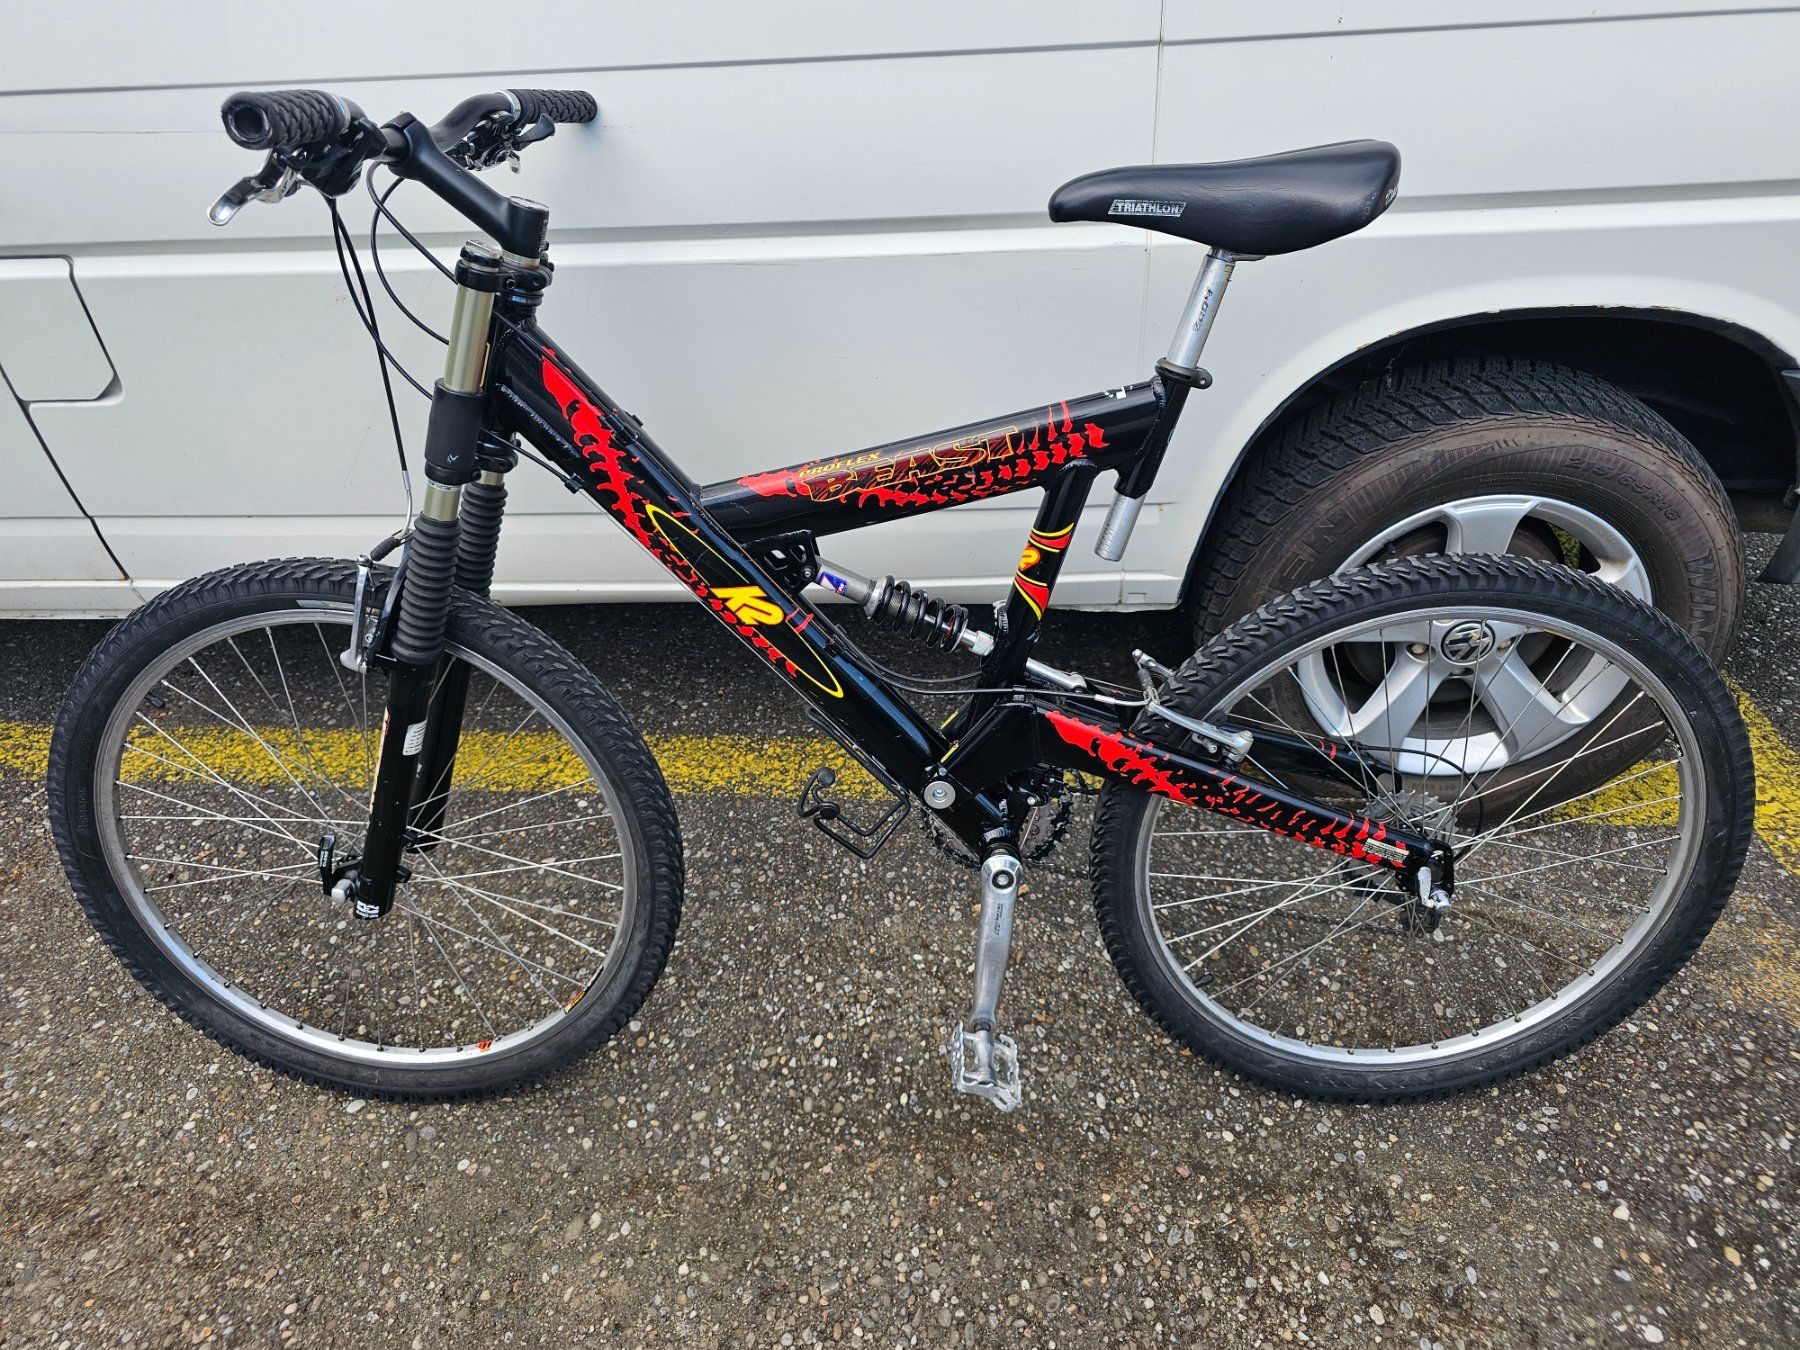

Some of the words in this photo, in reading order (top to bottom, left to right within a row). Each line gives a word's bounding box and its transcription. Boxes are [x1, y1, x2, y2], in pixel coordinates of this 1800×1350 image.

[1116, 202, 1179, 214] TRIATHLON
[798, 452, 881, 478] PROFLEX
[801, 426, 1019, 502] BEAST
[709, 585, 784, 625] K2
